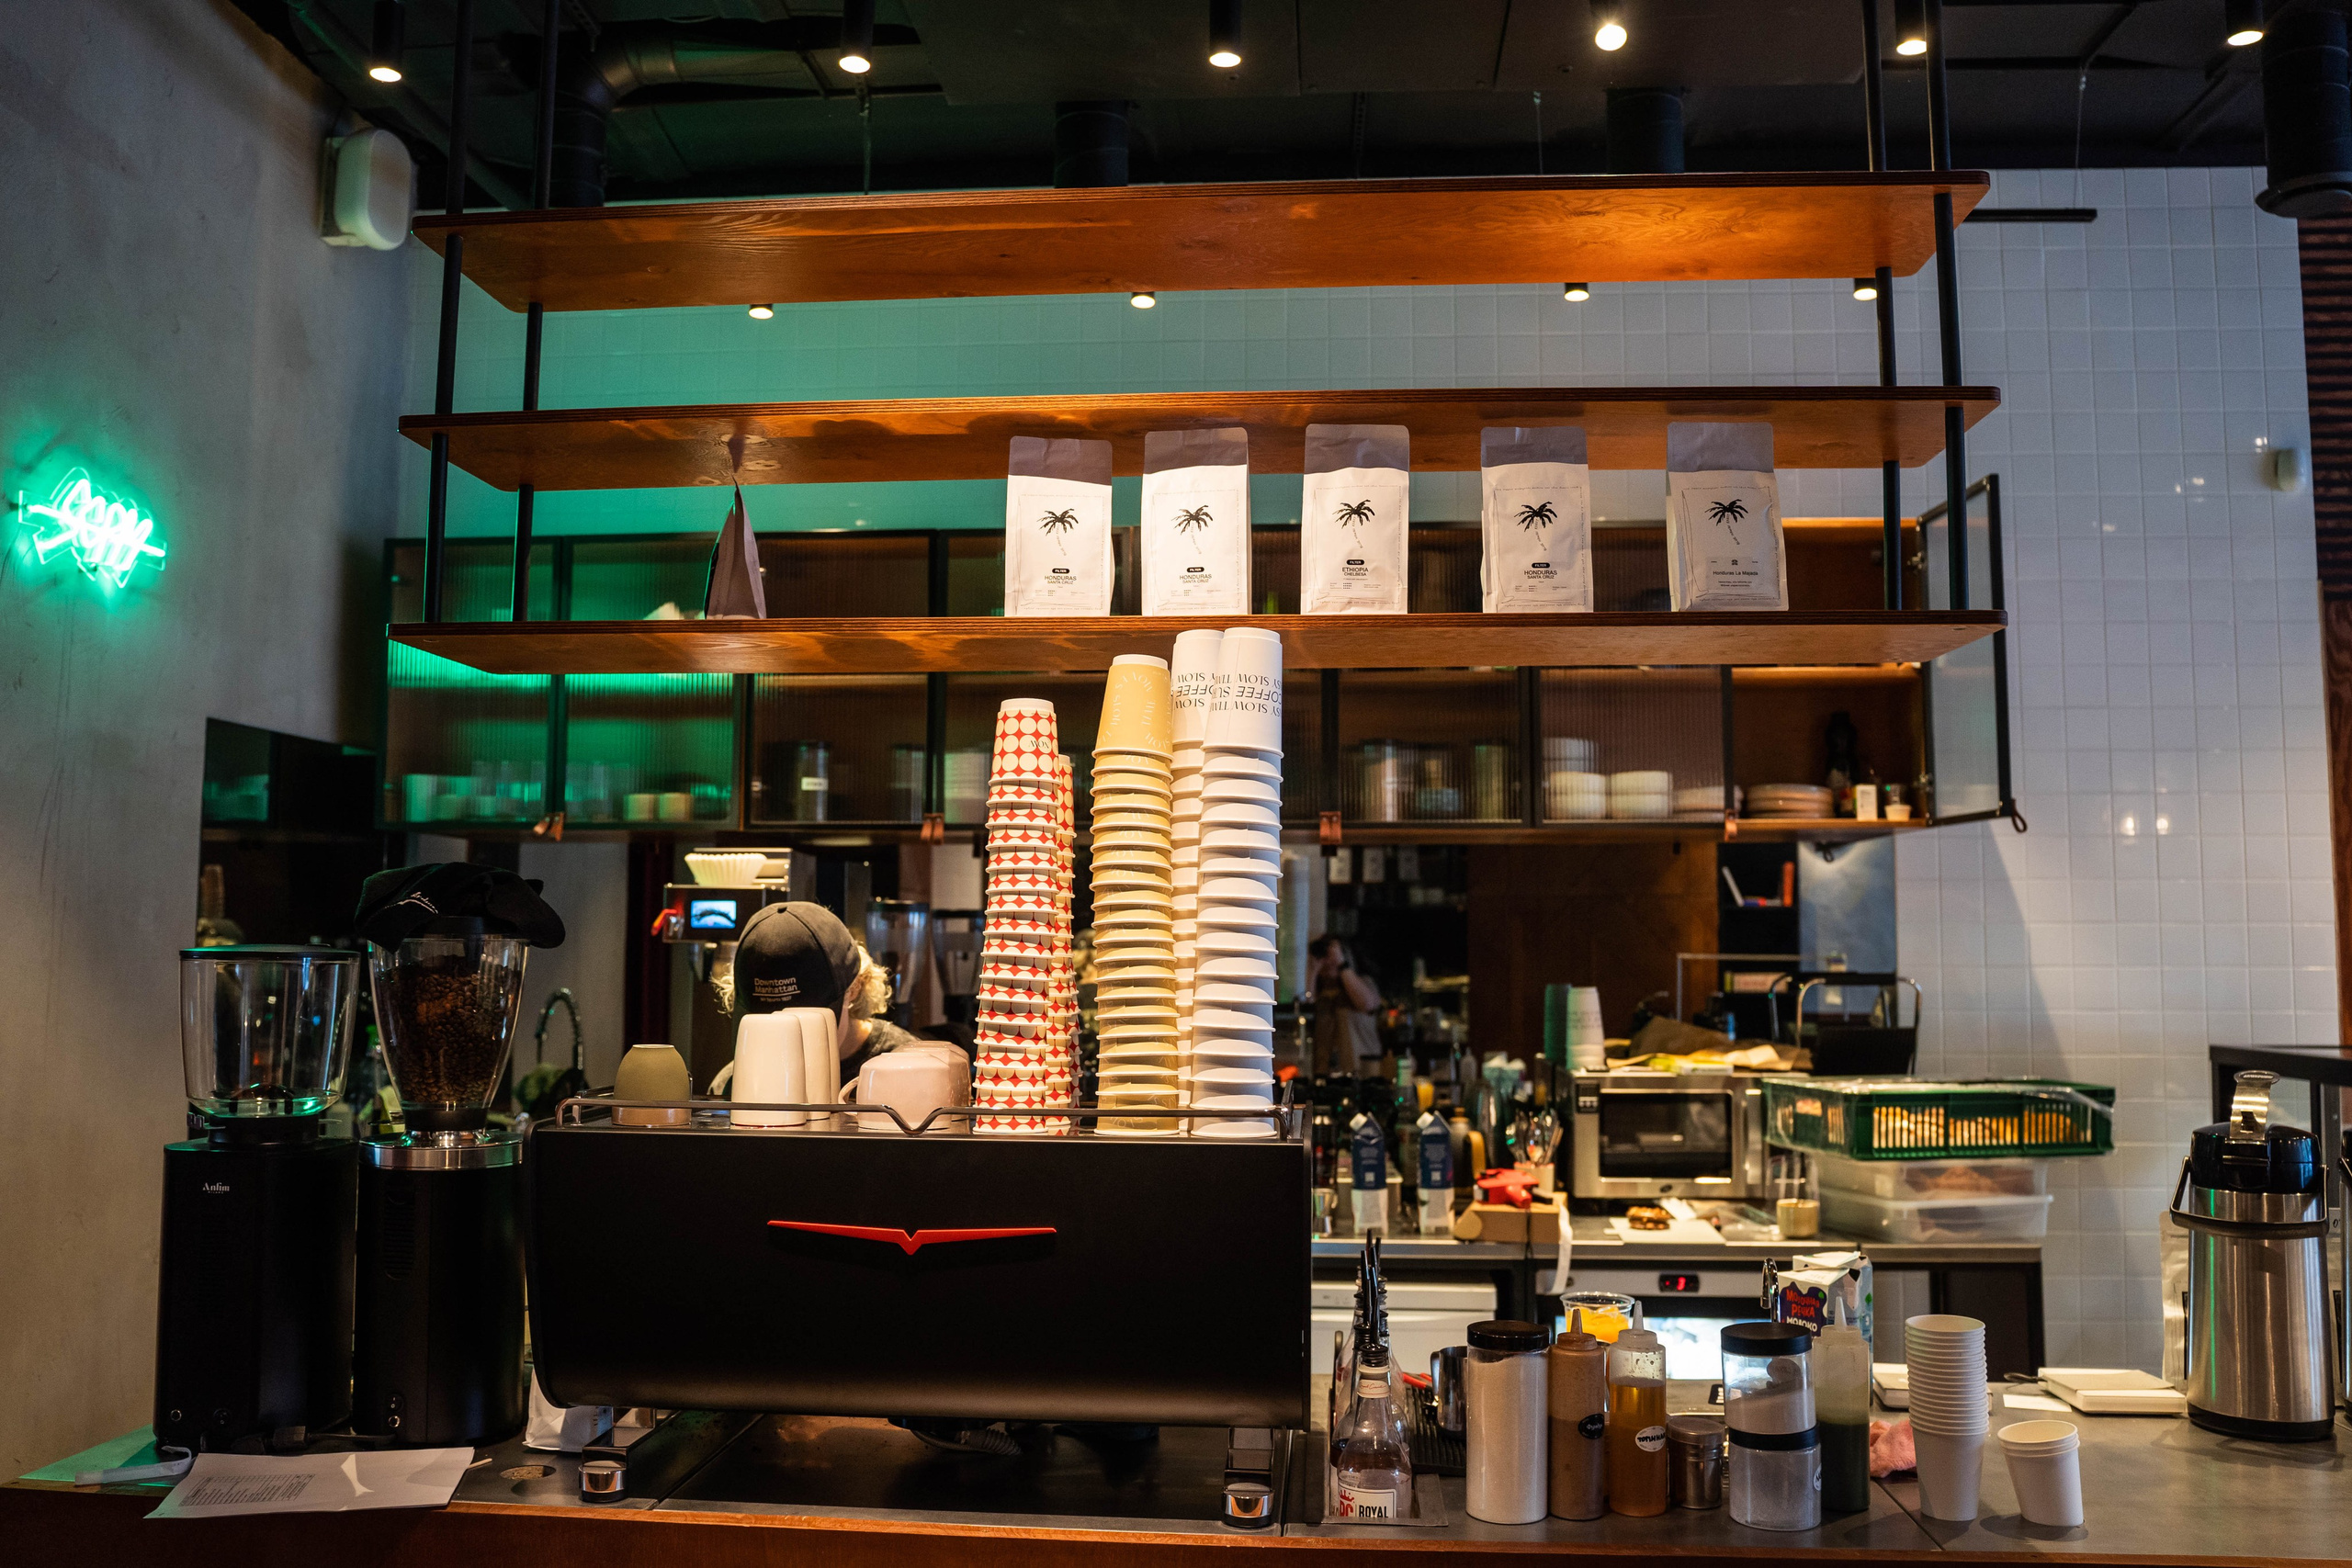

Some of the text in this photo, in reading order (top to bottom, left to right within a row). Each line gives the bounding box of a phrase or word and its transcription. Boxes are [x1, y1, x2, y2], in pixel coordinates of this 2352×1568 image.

[1177, 672, 1206, 683] SLOW
[1236, 672, 1270, 686] SLOW
[1176, 683, 1215, 698] OFFEE
[1175, 698, 1205, 710] SLOW
[1232, 701, 1268, 714] SLOW
[754, 977, 797, 986] Downtown
[755, 985, 797, 993] Manhattan
[202, 1182, 230, 1191] Anfim
[1792, 1303, 1815, 1318] РЕЧКА
[1359, 1505, 1389, 1517] ROYAL
